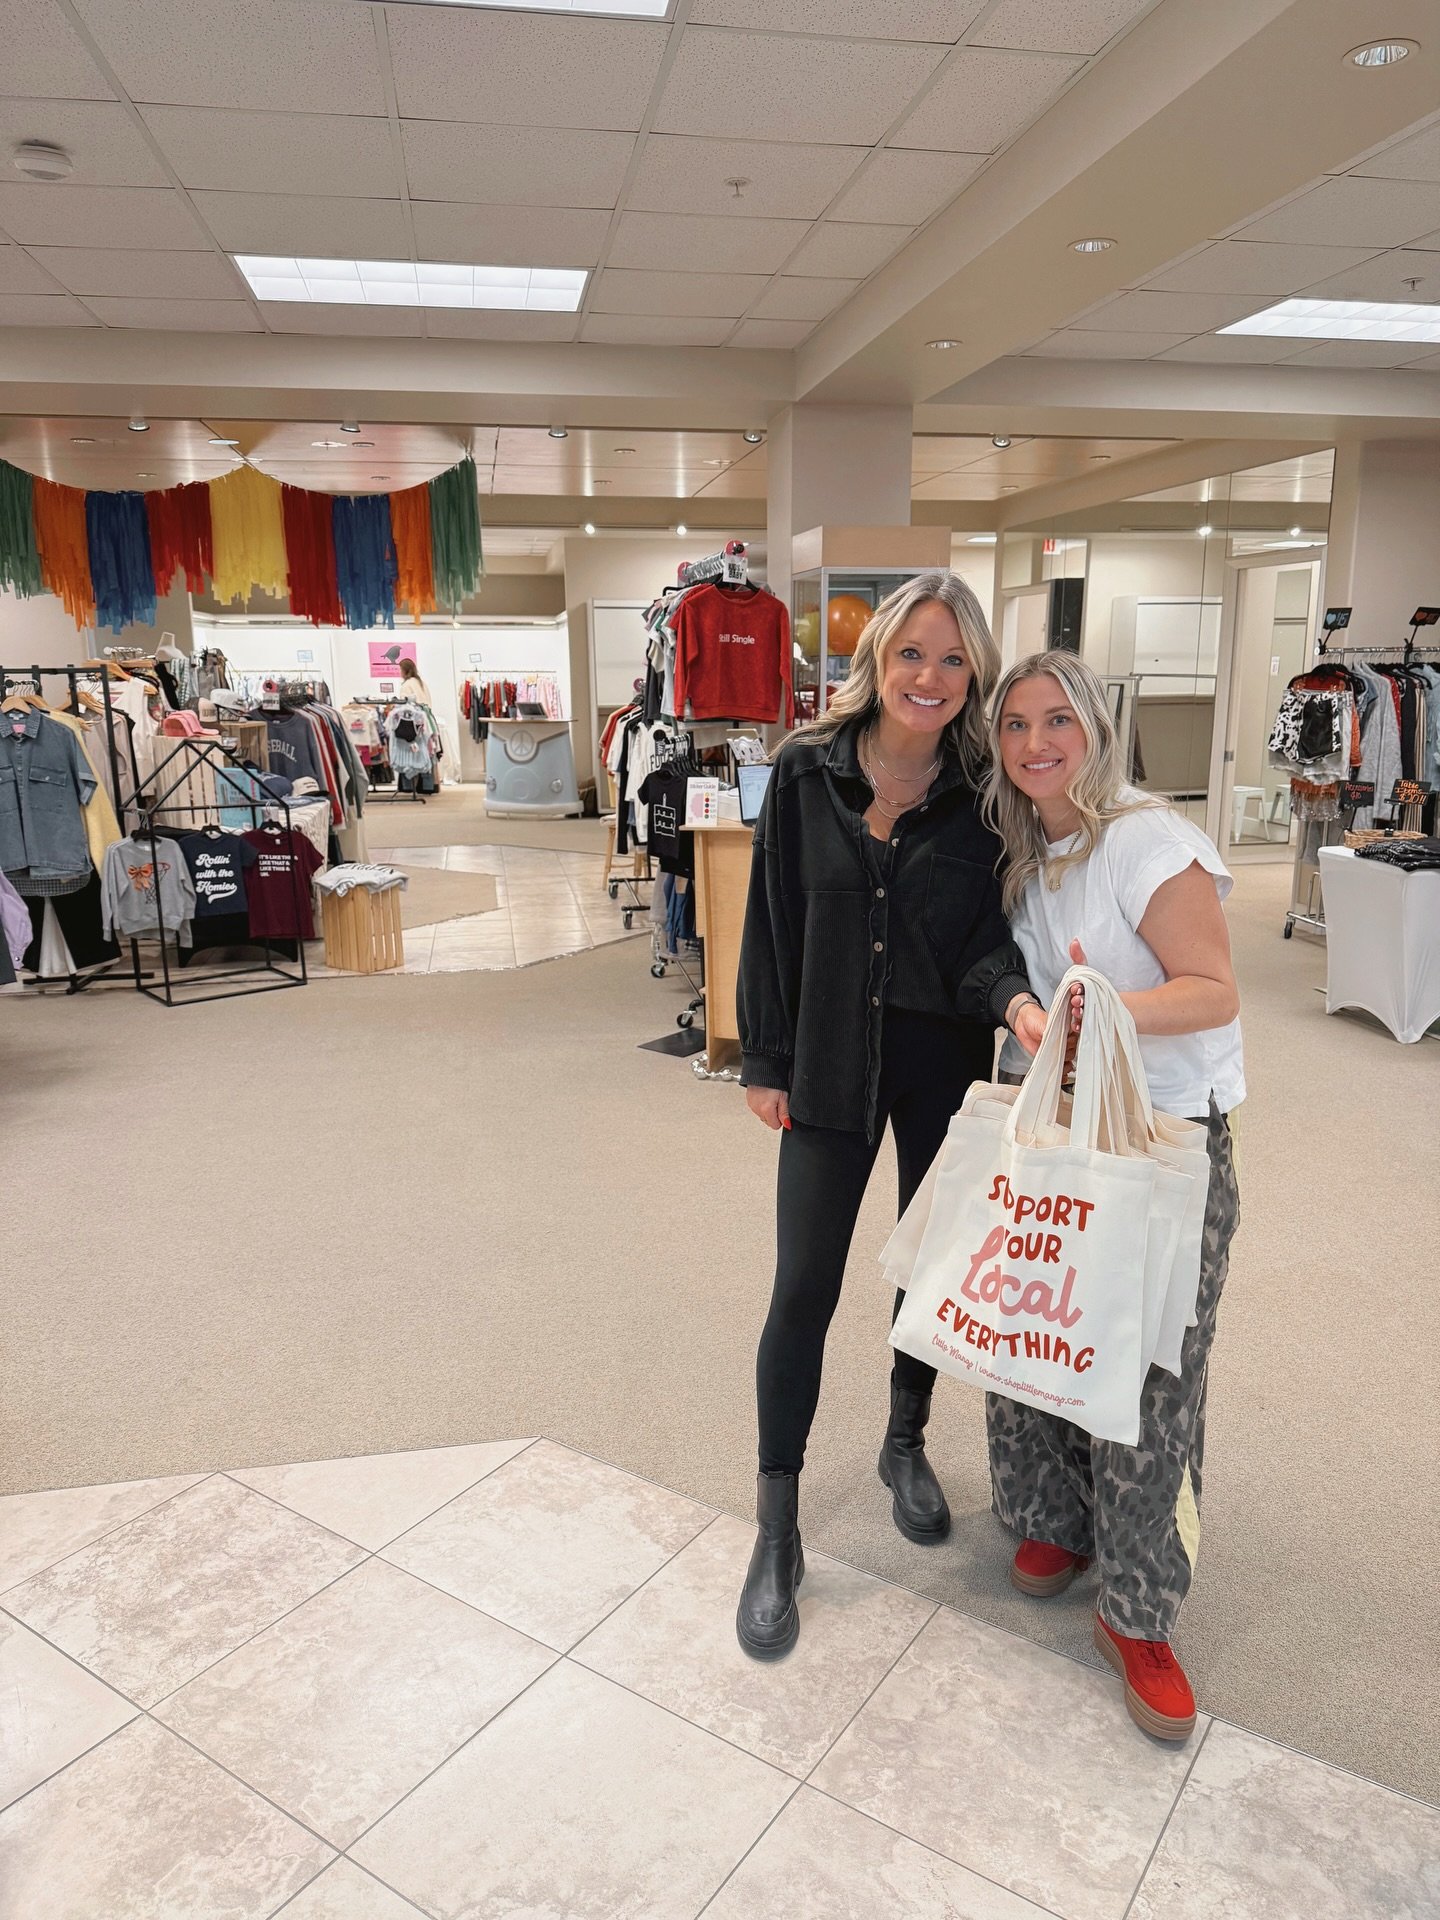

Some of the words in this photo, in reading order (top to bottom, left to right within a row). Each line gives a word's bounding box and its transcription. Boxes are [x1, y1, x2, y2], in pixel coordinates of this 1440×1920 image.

[731, 634, 755, 645] Single
[195, 869, 217, 879] with
[218, 868, 234, 878] the
[195, 880, 238, 900] Homies
[1005, 1229, 1062, 1264] OUR
[949, 1345, 974, 1371] Mango
